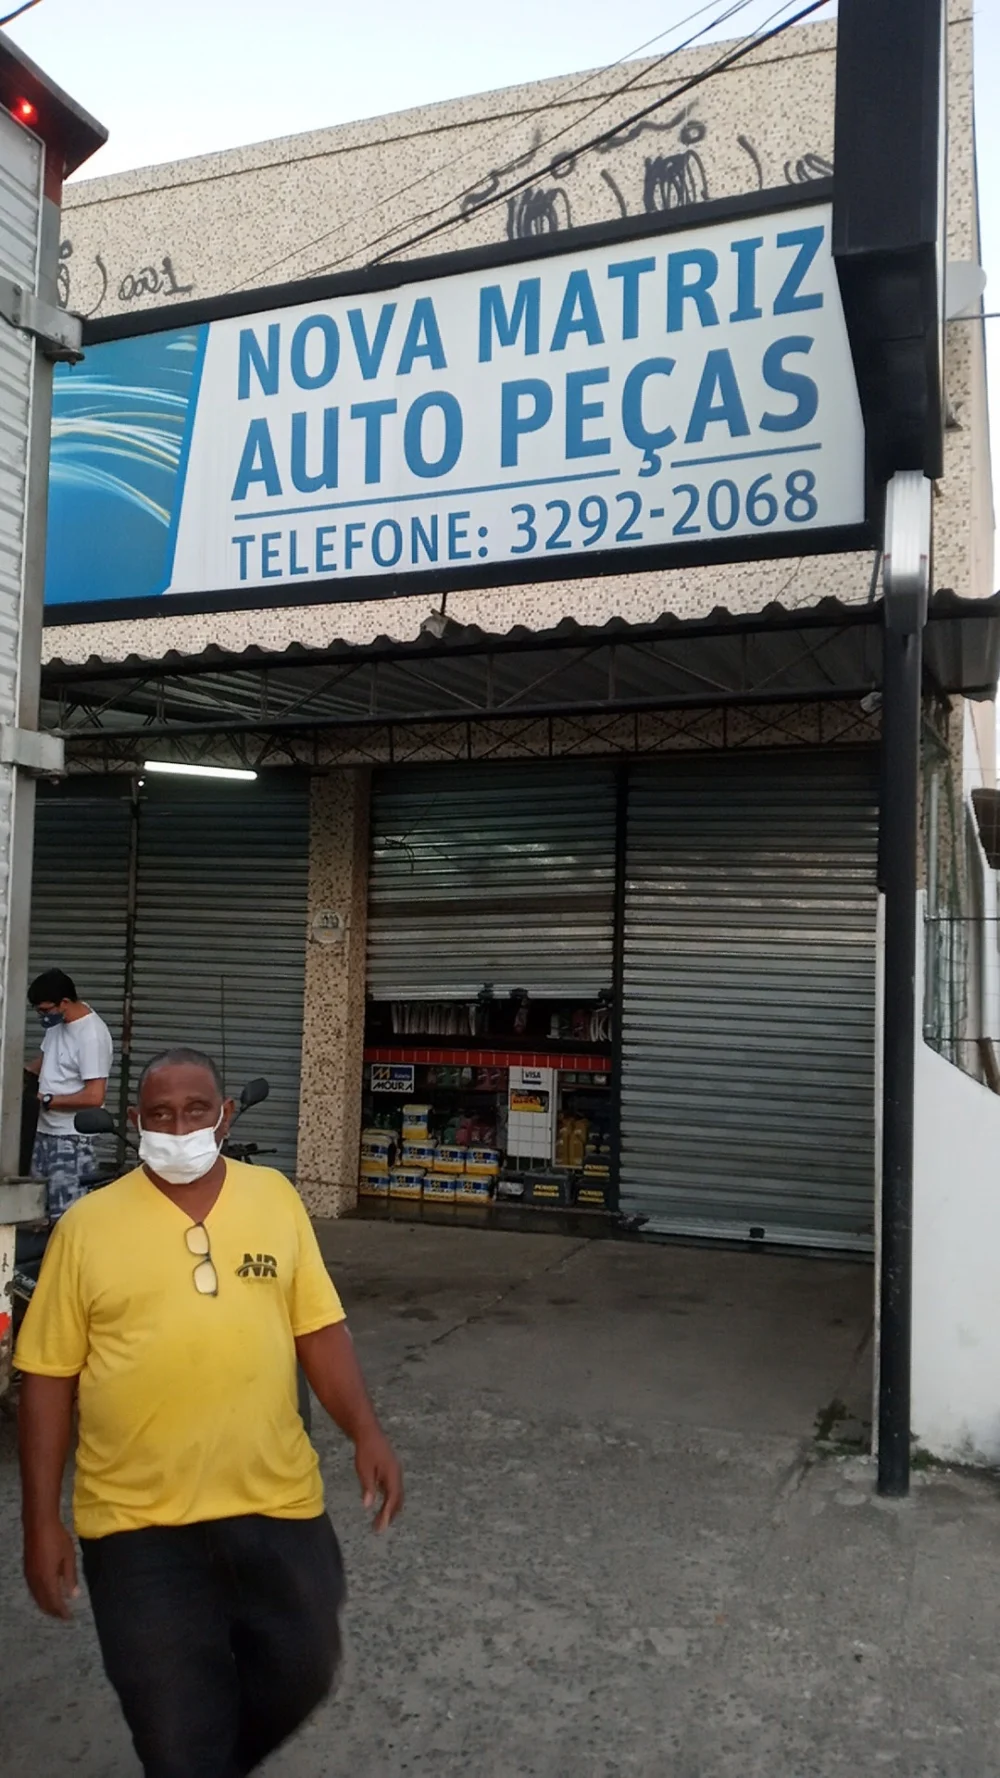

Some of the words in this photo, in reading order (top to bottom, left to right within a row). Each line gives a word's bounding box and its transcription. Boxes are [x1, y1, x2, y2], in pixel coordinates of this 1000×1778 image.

[238, 297, 447, 400] NOVA
[478, 226, 826, 363] MATRIZ
[231, 391, 463, 501] AUTO
[500, 336, 819, 478] PEÇAS
[232, 512, 488, 581] TELEFONE:
[510, 470, 817, 554] 3292-2068
[373, 1081, 412, 1090] MOURA
[525, 1071, 541, 1079] VISA
